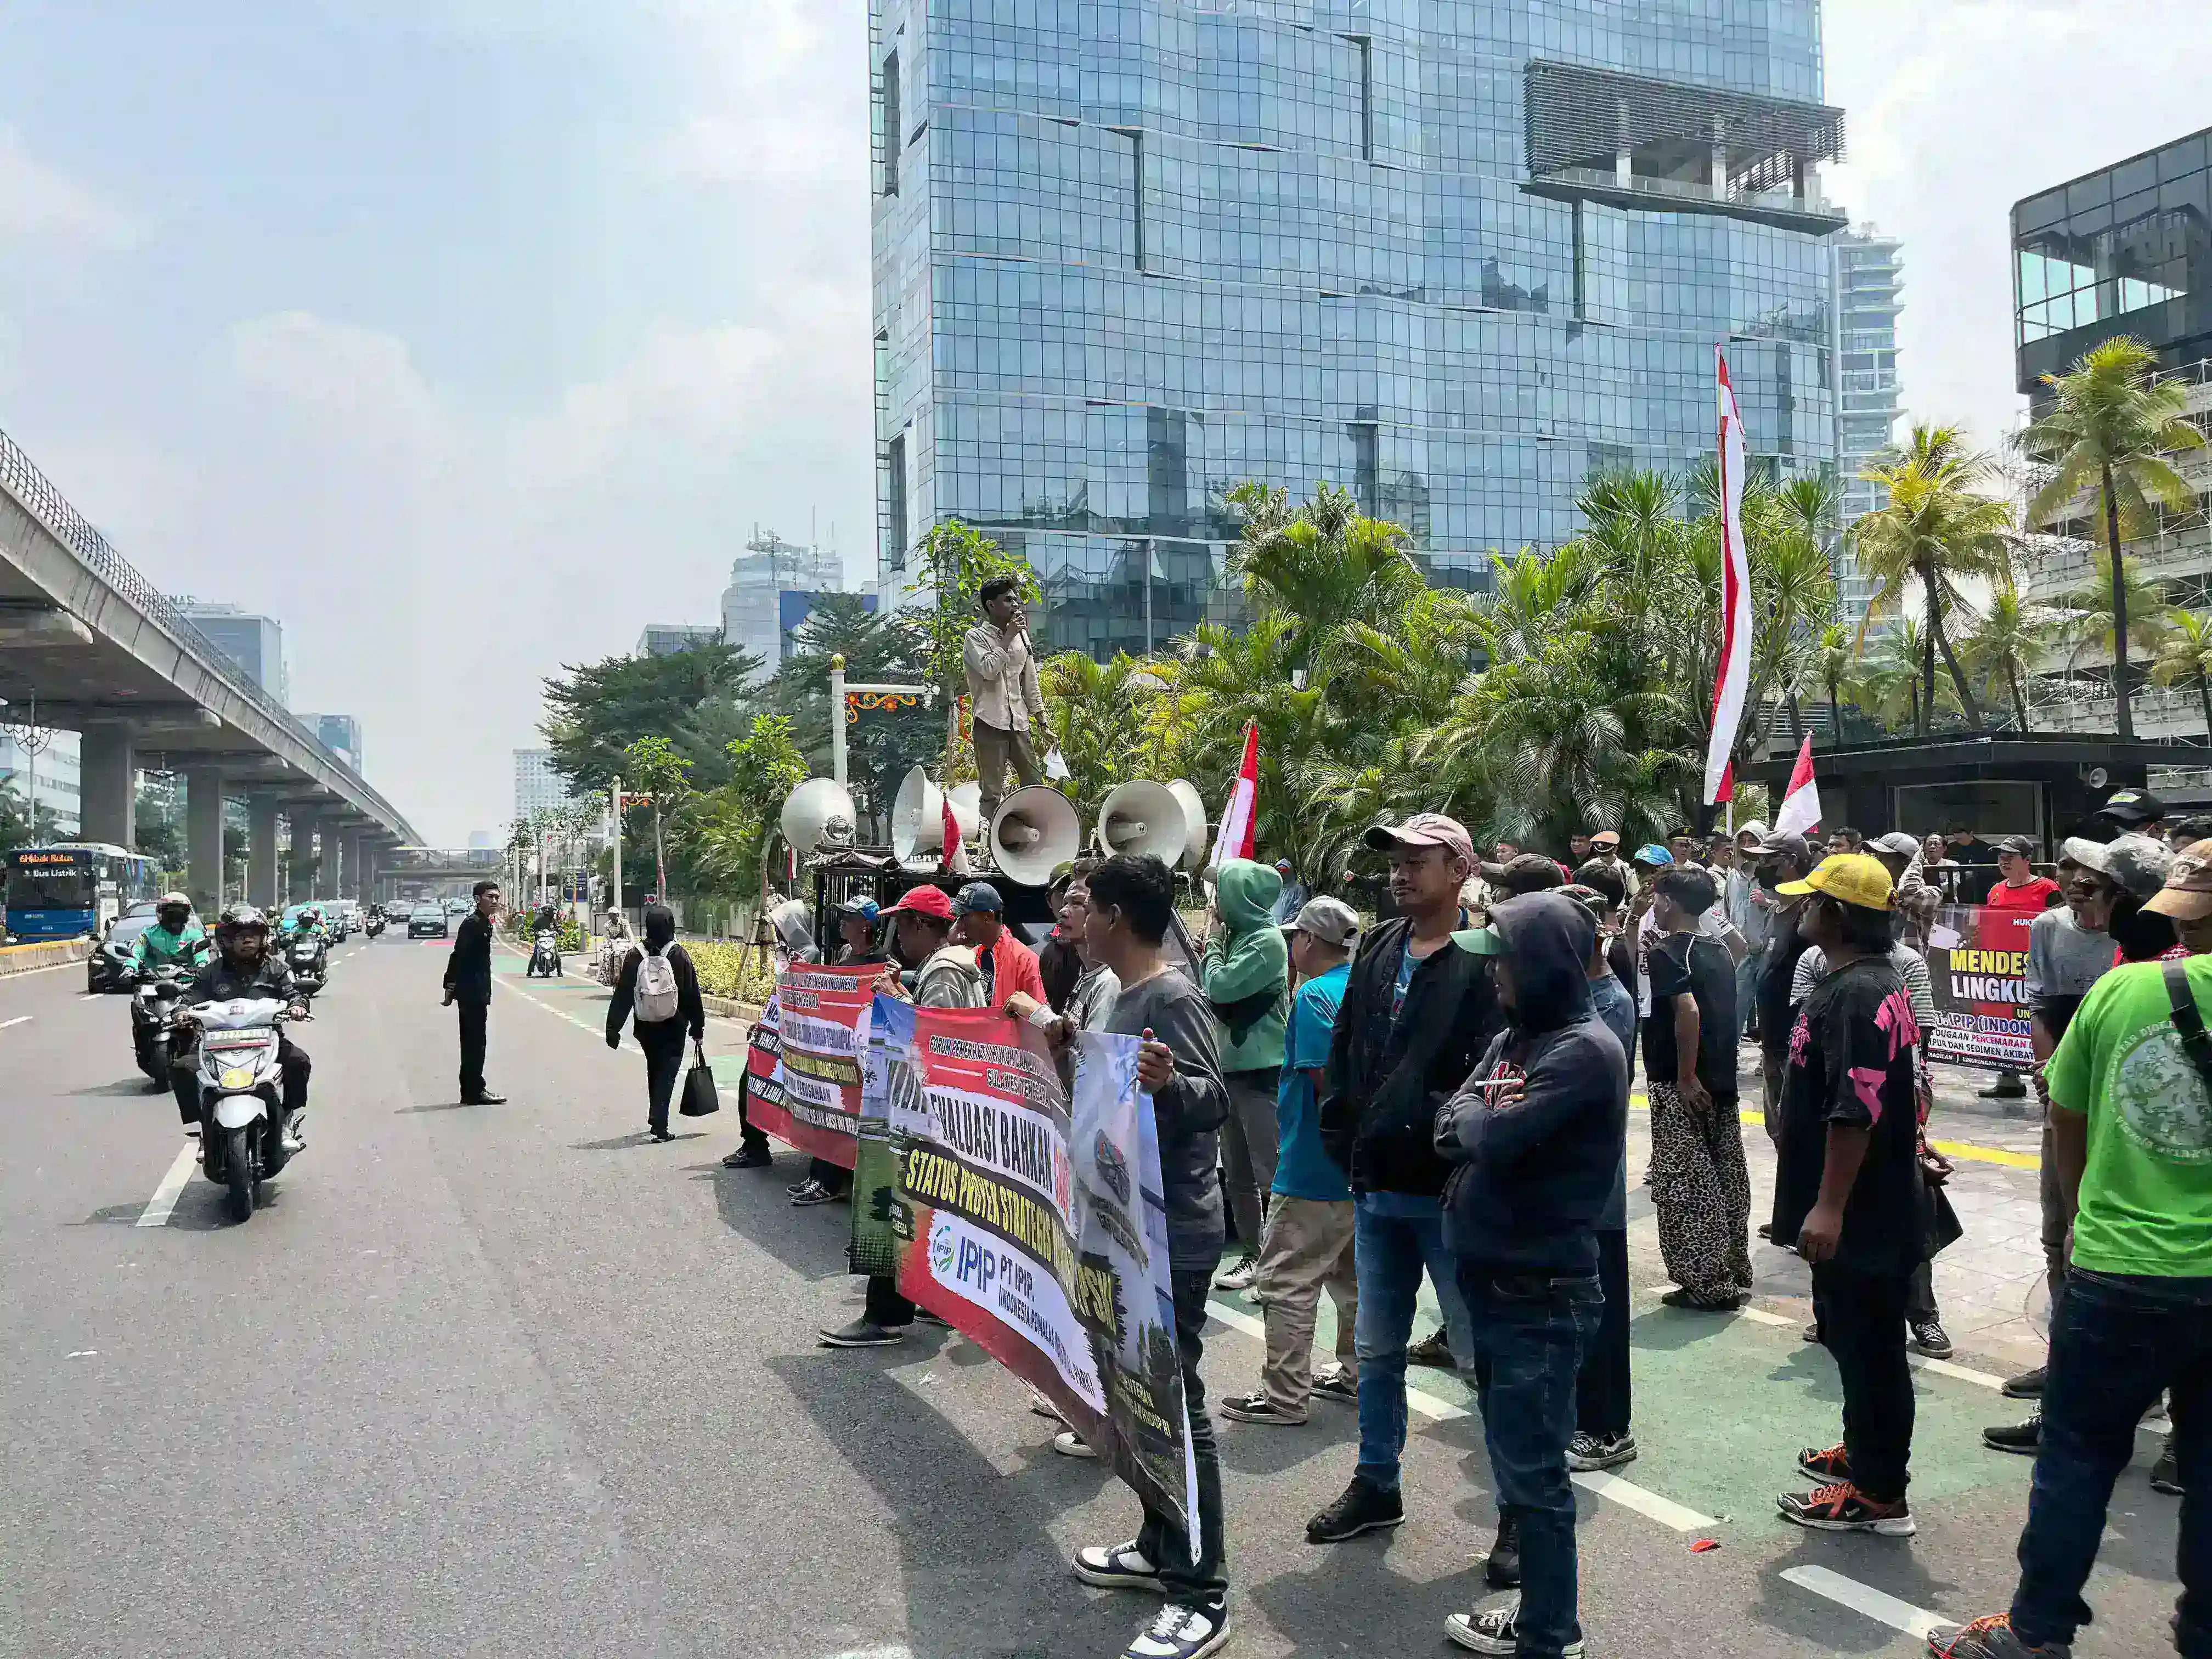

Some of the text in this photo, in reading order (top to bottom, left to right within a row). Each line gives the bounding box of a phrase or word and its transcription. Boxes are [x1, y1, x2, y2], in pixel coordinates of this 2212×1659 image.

[1936, 1029, 2027, 1048] DUGAAN PENCEMARAN
[1948, 1041, 1964, 1051] DAN
[1966, 1044, 2001, 1057] SEDIMEN
[2004, 1049, 2034, 1061] AKIBAT
[930, 1092, 997, 1164] EVALUASI
[1000, 1111, 1053, 1194] BAHKAN
[906, 1148, 959, 1204] STATUS
[958, 1166, 1000, 1227] PROYEK
[956, 1235, 996, 1294] IPIP
[1000, 1254, 1013, 1285] PT
